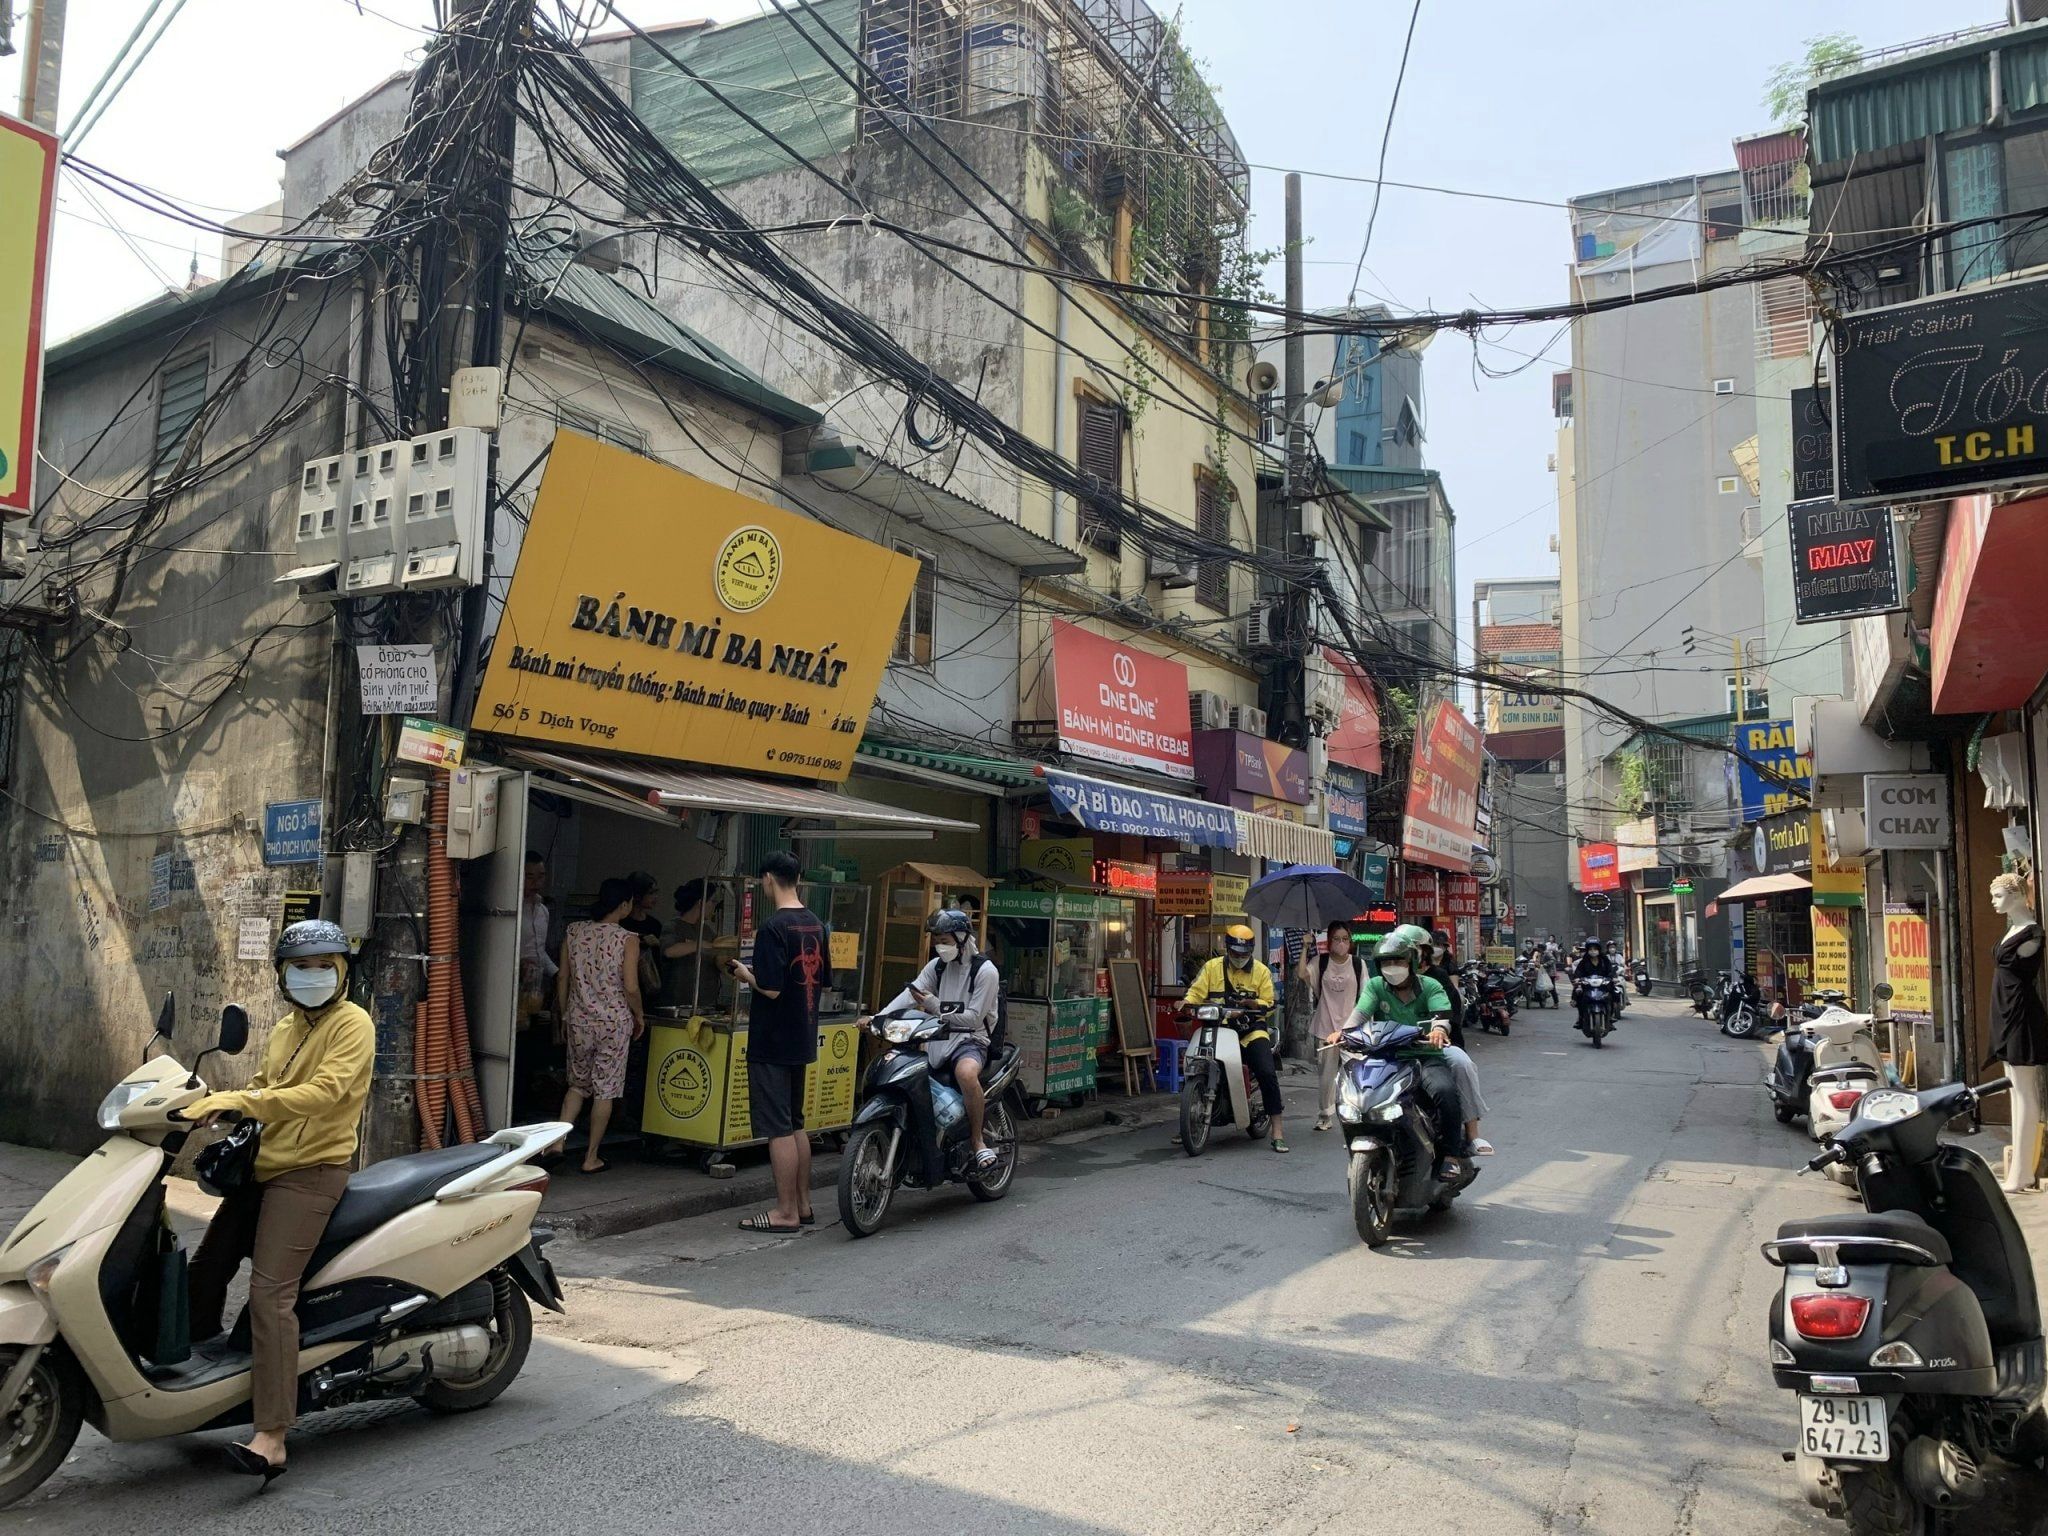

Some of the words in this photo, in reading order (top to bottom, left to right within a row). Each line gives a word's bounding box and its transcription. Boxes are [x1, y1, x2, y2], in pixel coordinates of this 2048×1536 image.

[1857, 324, 1903, 347] Hair
[1909, 314, 1974, 337] Salon
[1934, 424, 2035, 466] T.C.H
[1794, 468, 1834, 492] VEGE
[1809, 539, 1874, 570] MAY
[1801, 576, 1838, 599] BÍCH
[571, 591, 677, 649] BÁNH
[677, 616, 721, 659] MÌ
[722, 633, 762, 670] BA
[768, 641, 848, 688] NHẤT
[407, 667, 427, 679] CHO
[507, 645, 552, 676] Bánh
[577, 661, 625, 691] truyền
[673, 680, 705, 707] Bánh
[725, 692, 746, 713] heo
[748, 700, 776, 722] quay
[781, 703, 810, 725] Bánh
[492, 702, 519, 720] Số
[520, 708, 530, 721] 5
[538, 710, 574, 729] Dịch
[580, 717, 618, 738] Vọng
[1063, 706, 1098, 735] BÁNH
[1101, 715, 1114, 739] MÌ
[1115, 720, 1155, 749] DÖNER
[1156, 734, 1189, 757] KEBAB
[1880, 787, 1937, 805] CƠM
[277, 809, 298, 832] NGÕ
[301, 814, 307, 830] 3
[1091, 788, 1107, 813] BÍ
[1111, 795, 1143, 819] ĐAO
[1151, 801, 1177, 825] TRÀ
[1179, 808, 1206, 830] HOA
[1207, 810, 1232, 834] QUẢ
[1122, 823, 1150, 836] 0902
[1769, 824, 1788, 851] Food
[1788, 831, 1794, 847] &
[1878, 817, 1941, 835] CHAY
[266, 838, 280, 856] PHỐ
[282, 843, 299, 857] DỊCH
[1003, 900, 1019, 908] HOA
[1466, 899, 1475, 912] XE
[1888, 917, 1927, 958] CƠM
[1787, 958, 1809, 979] PHỞ
[1905, 961, 1930, 979] PHÒNG
[1812, 1399, 1872, 1426] 29-D1
[1806, 1427, 1882, 1456] 647.23
